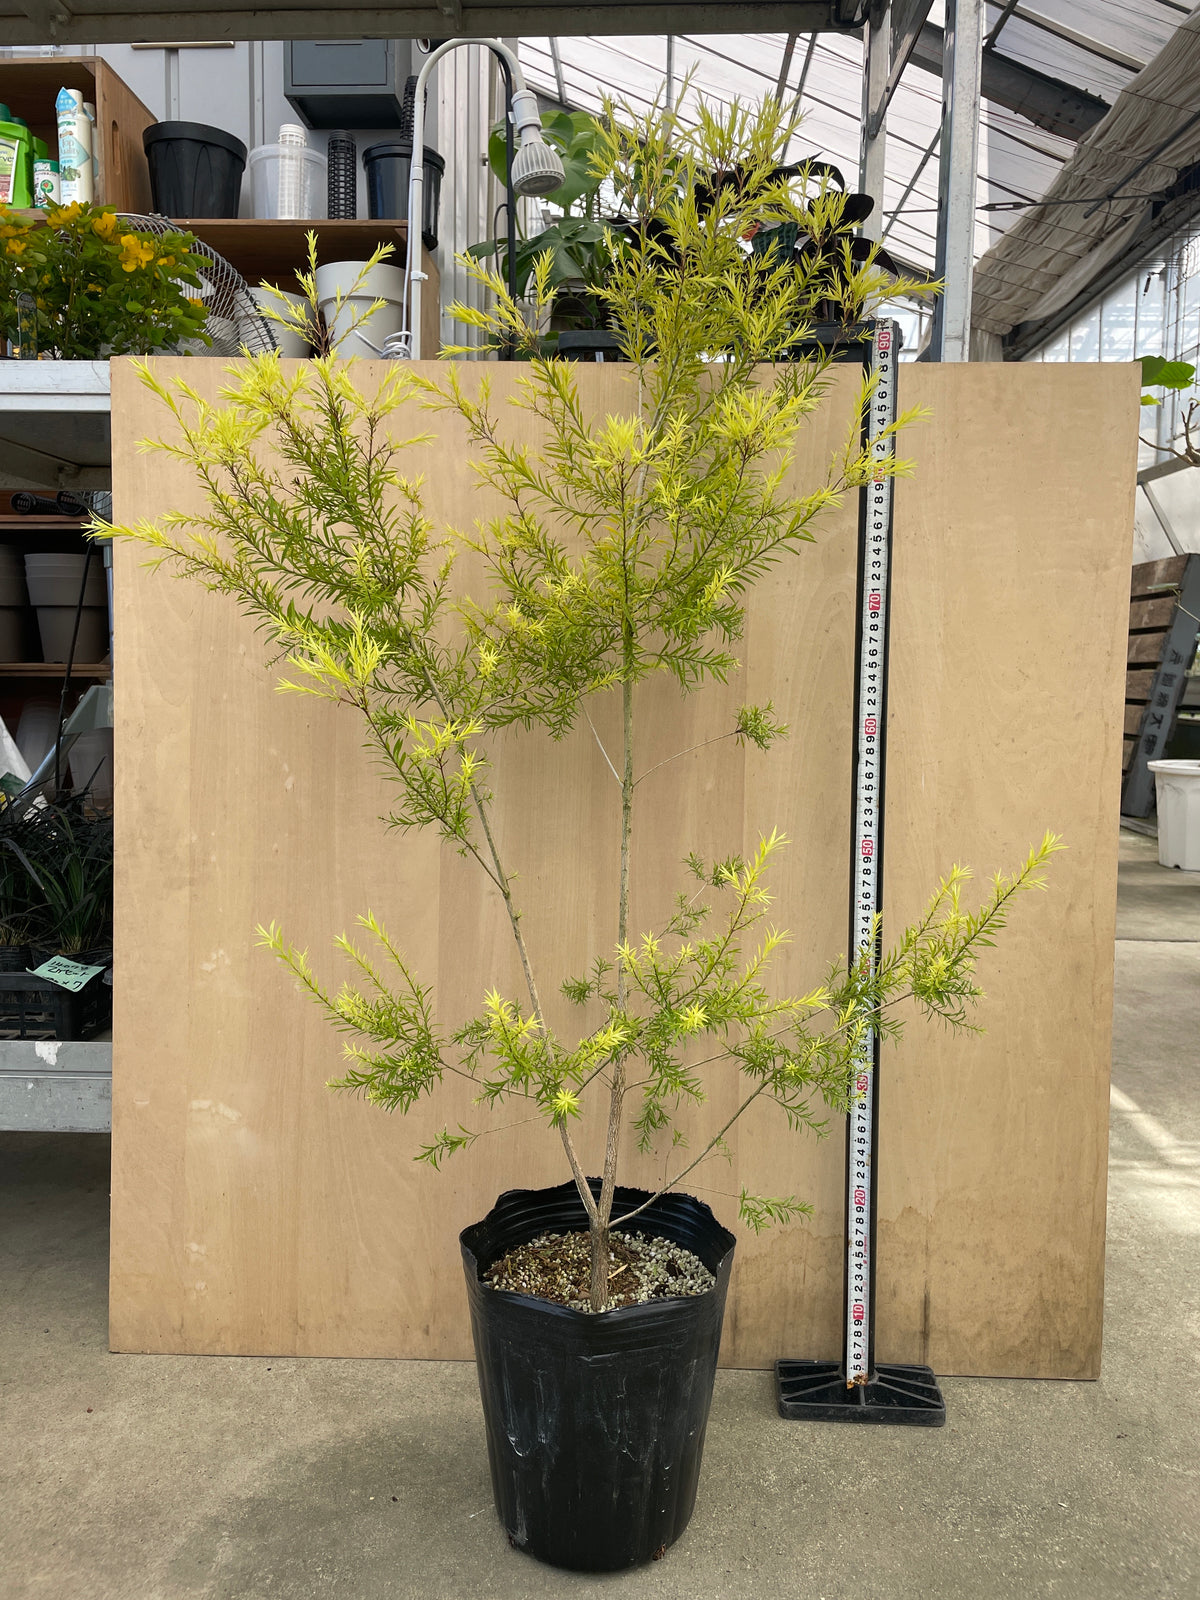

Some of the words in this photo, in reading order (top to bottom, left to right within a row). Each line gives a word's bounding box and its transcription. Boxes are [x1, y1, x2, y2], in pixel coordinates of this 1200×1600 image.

[880, 333, 889, 349] 90
[879, 351, 888, 360] 9
[878, 391, 887, 399] 6
[877, 404, 887, 412] 5
[877, 417, 886, 425] 4
[874, 496, 883, 504] 8
[872, 560, 881, 568] 3
[870, 595, 880, 608] 70
[870, 611, 879, 619] 9
[867, 698, 876, 706] 2
[866, 720, 875, 733] 60
[863, 841, 872, 854] 50
[856, 1190, 865, 1204] 20
[854, 1305, 864, 1318] 10
